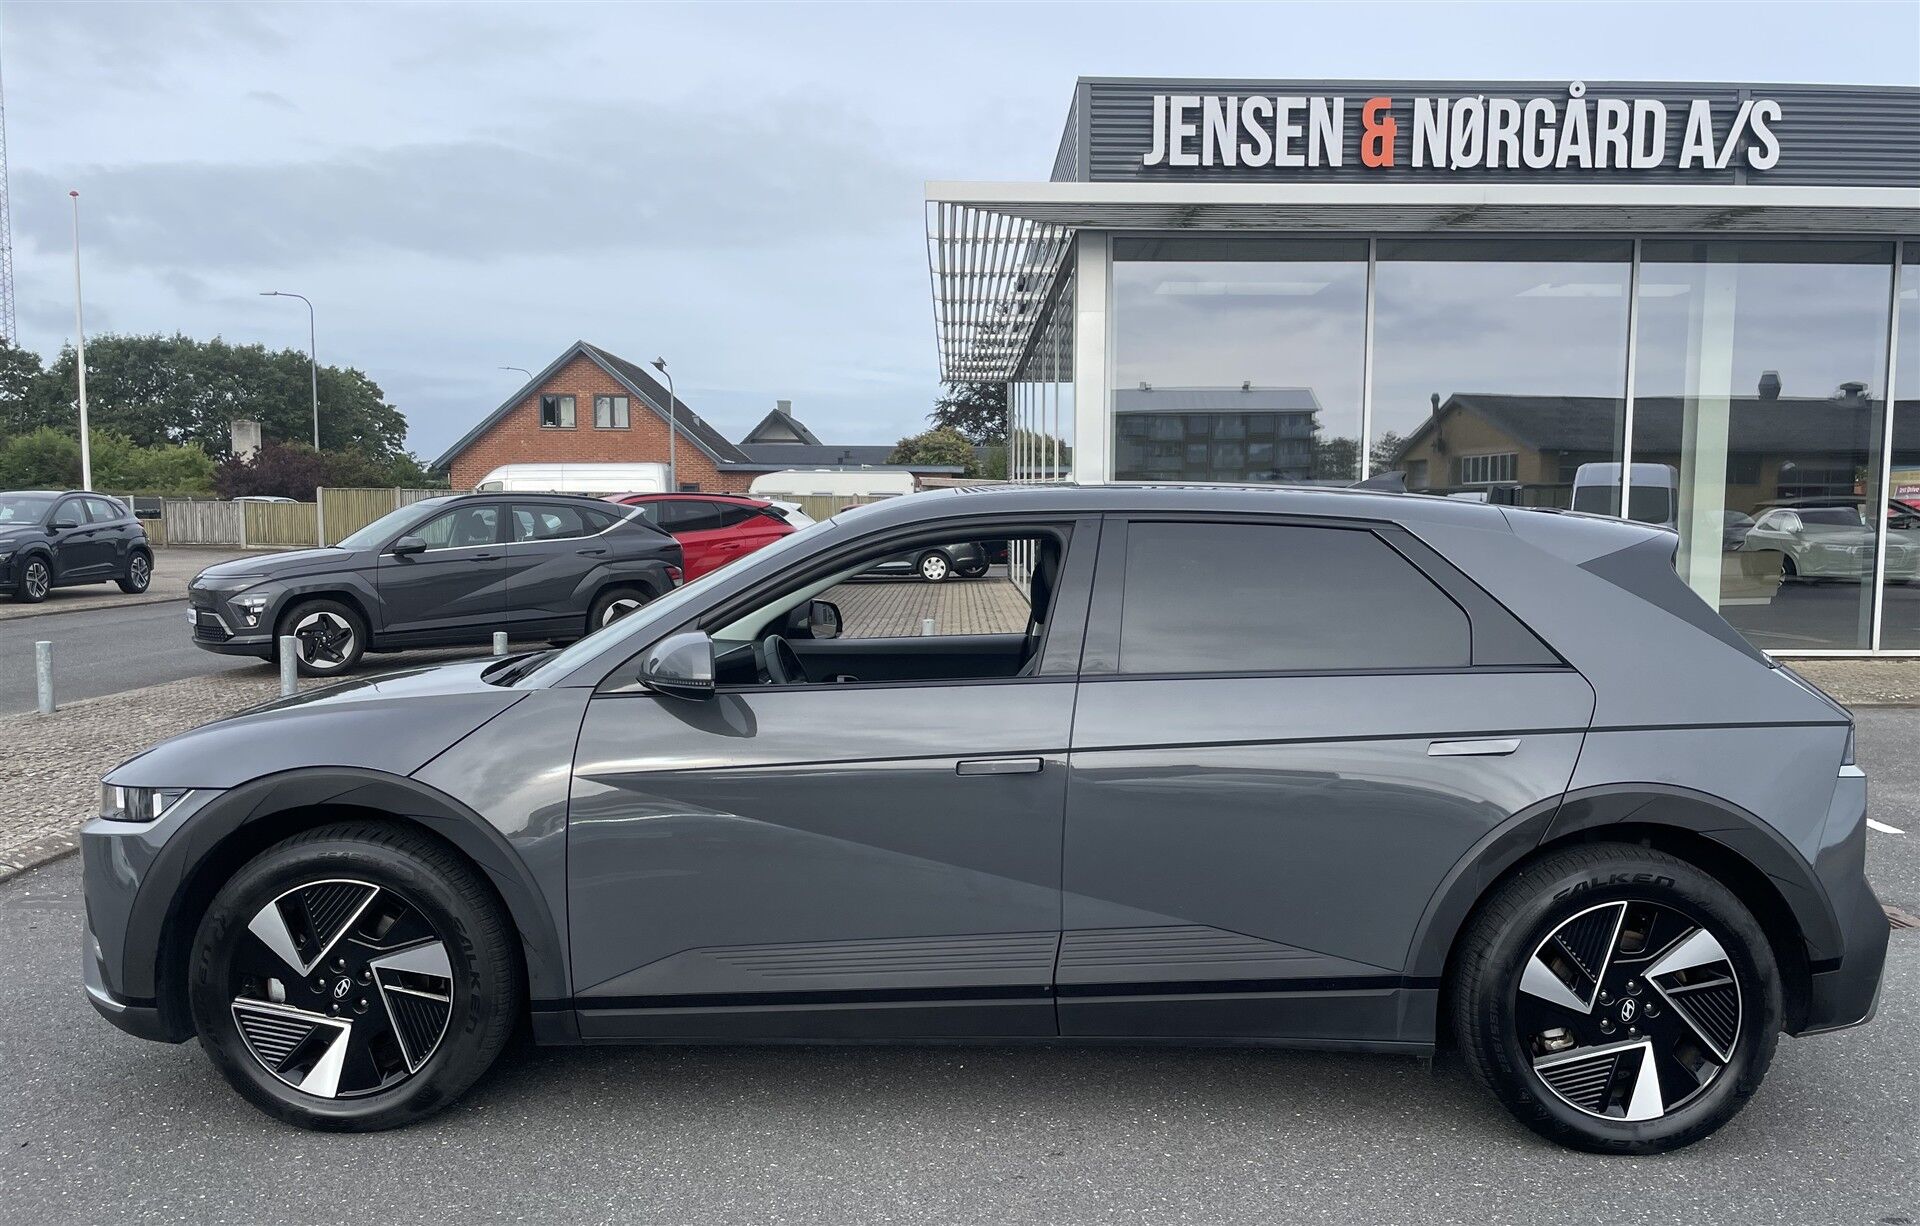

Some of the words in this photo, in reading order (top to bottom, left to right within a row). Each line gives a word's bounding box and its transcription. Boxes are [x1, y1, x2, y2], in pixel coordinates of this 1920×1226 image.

[1143, 95, 1344, 167] JENSEN
[1360, 97, 1397, 168] &
[1412, 80, 1666, 171] NØRGÅRD
[1679, 99, 1783, 170] A/S
[1552, 872, 1676, 900] FALKEN
